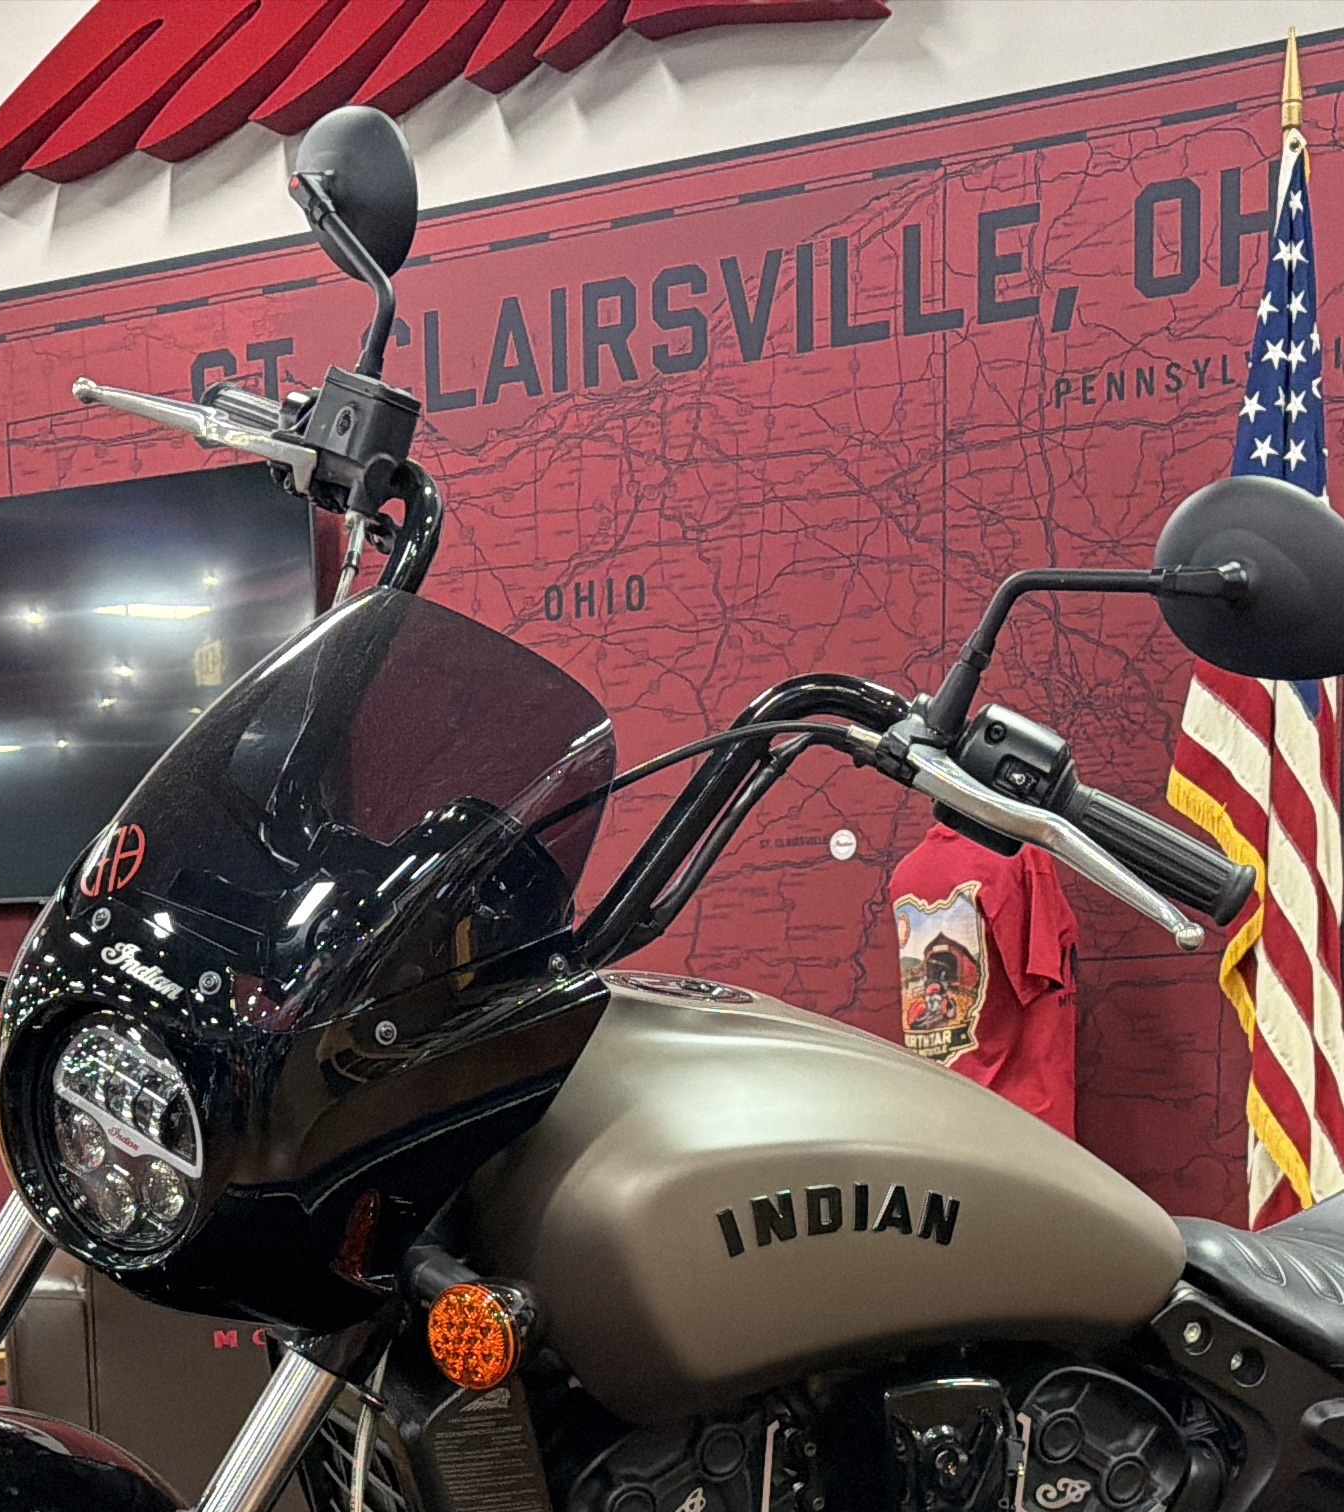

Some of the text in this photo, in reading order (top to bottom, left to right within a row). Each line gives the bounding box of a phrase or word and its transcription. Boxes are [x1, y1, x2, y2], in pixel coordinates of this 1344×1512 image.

[544, 574, 646, 622] OHIO
[101, 942, 185, 1001] Indian
[716, 1180, 961, 1258] INDIAN
